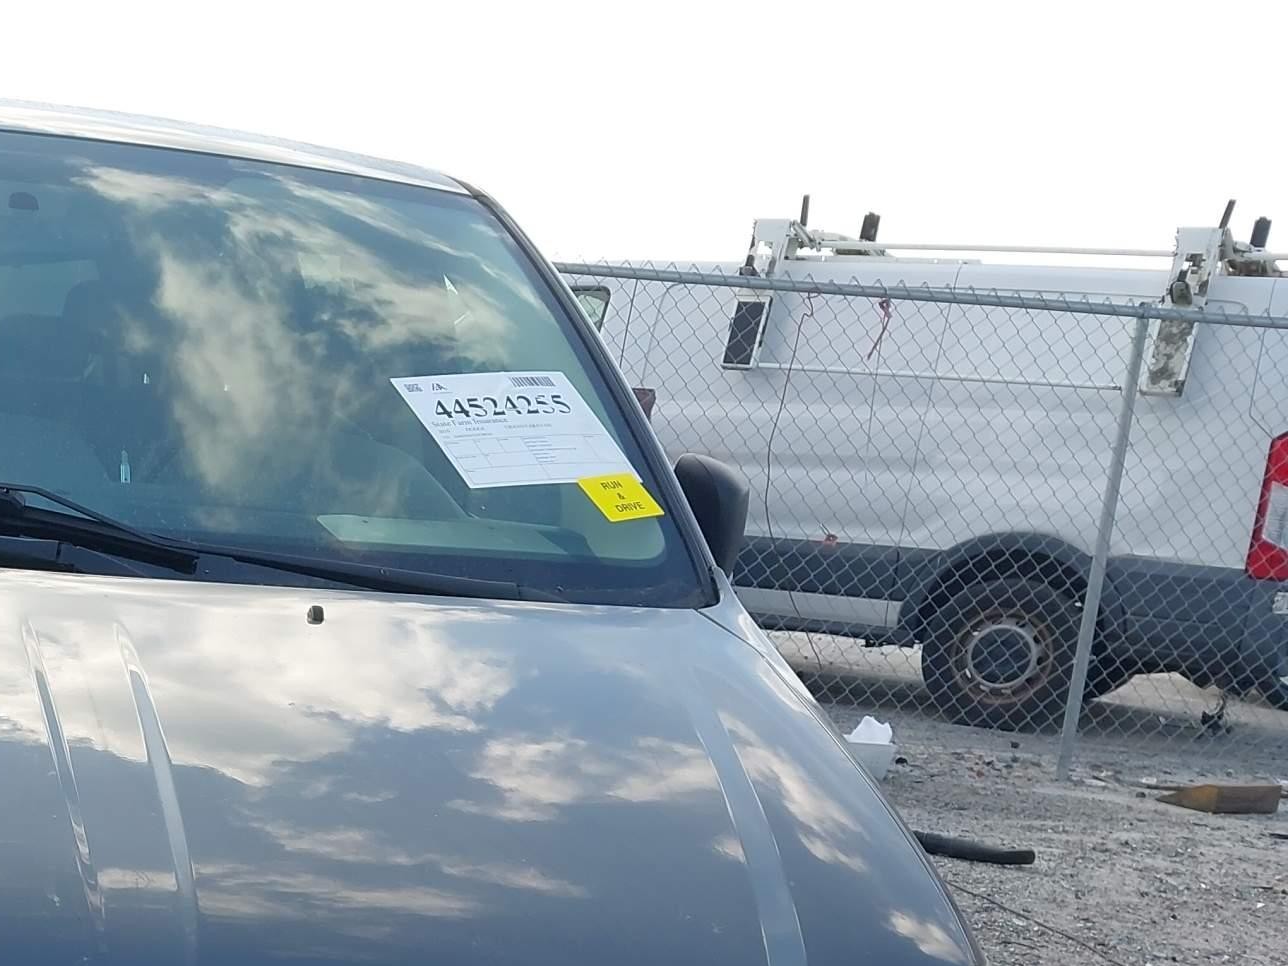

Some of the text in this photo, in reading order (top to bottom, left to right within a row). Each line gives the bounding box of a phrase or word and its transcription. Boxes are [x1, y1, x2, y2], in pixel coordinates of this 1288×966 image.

[435, 394, 572, 418] 44524255
[601, 480, 623, 490] RUN
[616, 502, 645, 513] DRIVE
